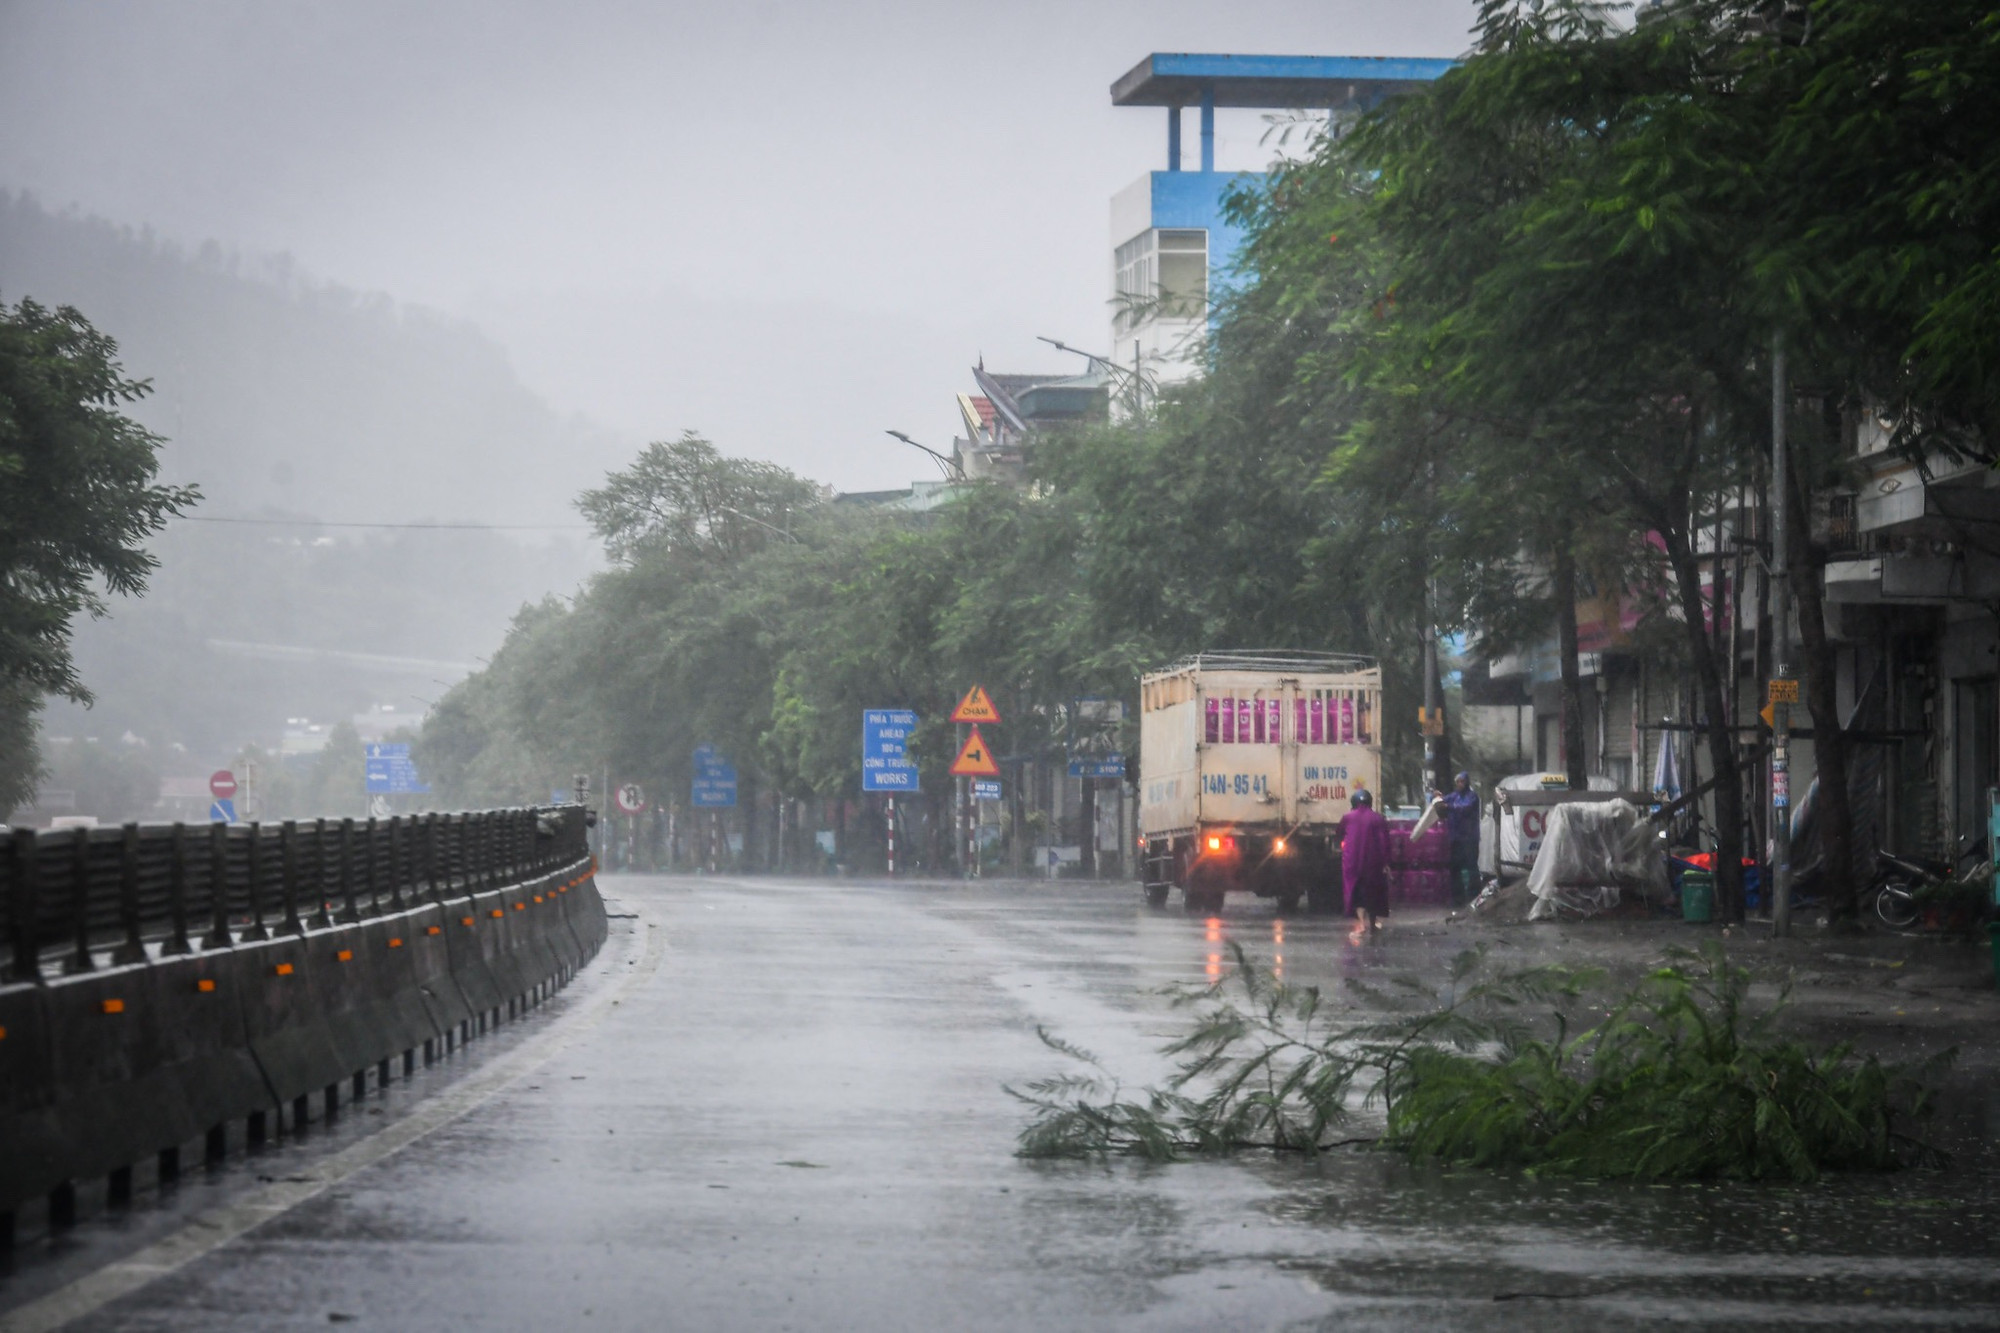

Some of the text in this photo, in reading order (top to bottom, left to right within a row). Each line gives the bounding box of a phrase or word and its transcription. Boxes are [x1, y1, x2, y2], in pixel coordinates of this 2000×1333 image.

[879, 729, 905, 739] AHEAD
[894, 745, 902, 753] m
[1304, 766, 1347, 780] UN 1075
[875, 773, 908, 784] WORKS
